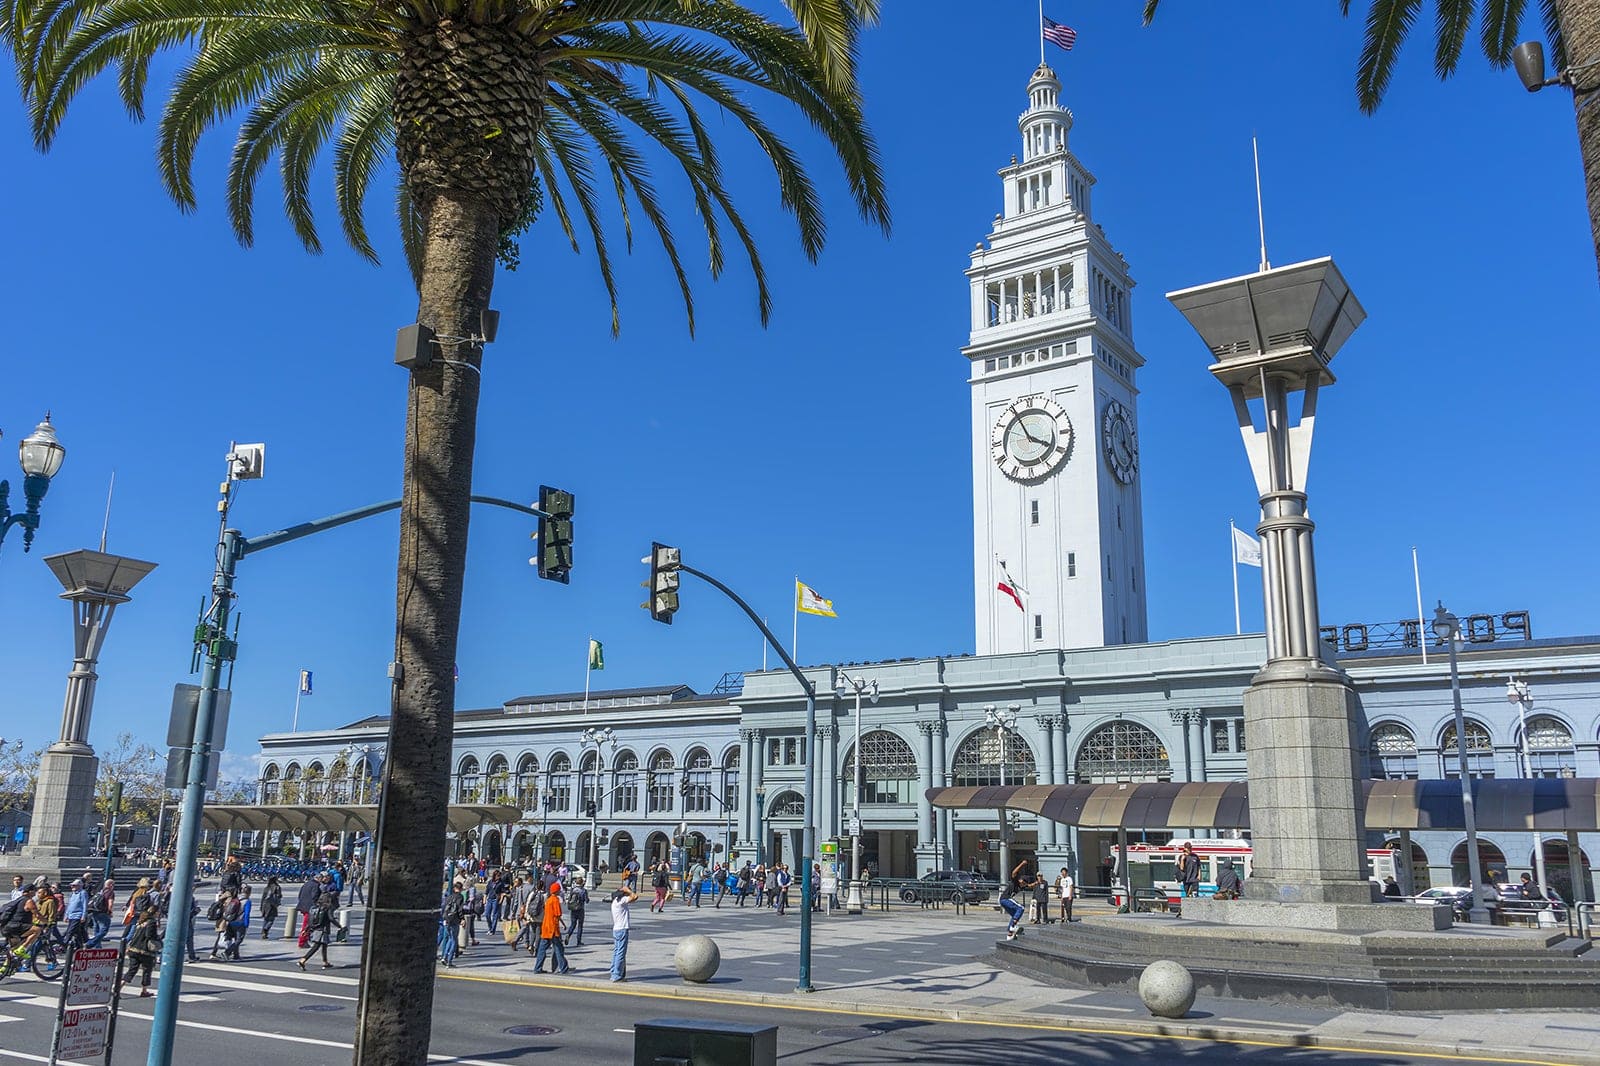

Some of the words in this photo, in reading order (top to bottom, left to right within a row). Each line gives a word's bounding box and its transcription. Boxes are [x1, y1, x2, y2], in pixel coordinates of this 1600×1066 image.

[79, 951, 114, 959] TOW-AWAY
[74, 960, 86, 971] NO
[65, 1011, 77, 1025] NO
[79, 1012, 106, 1022] PARKING
